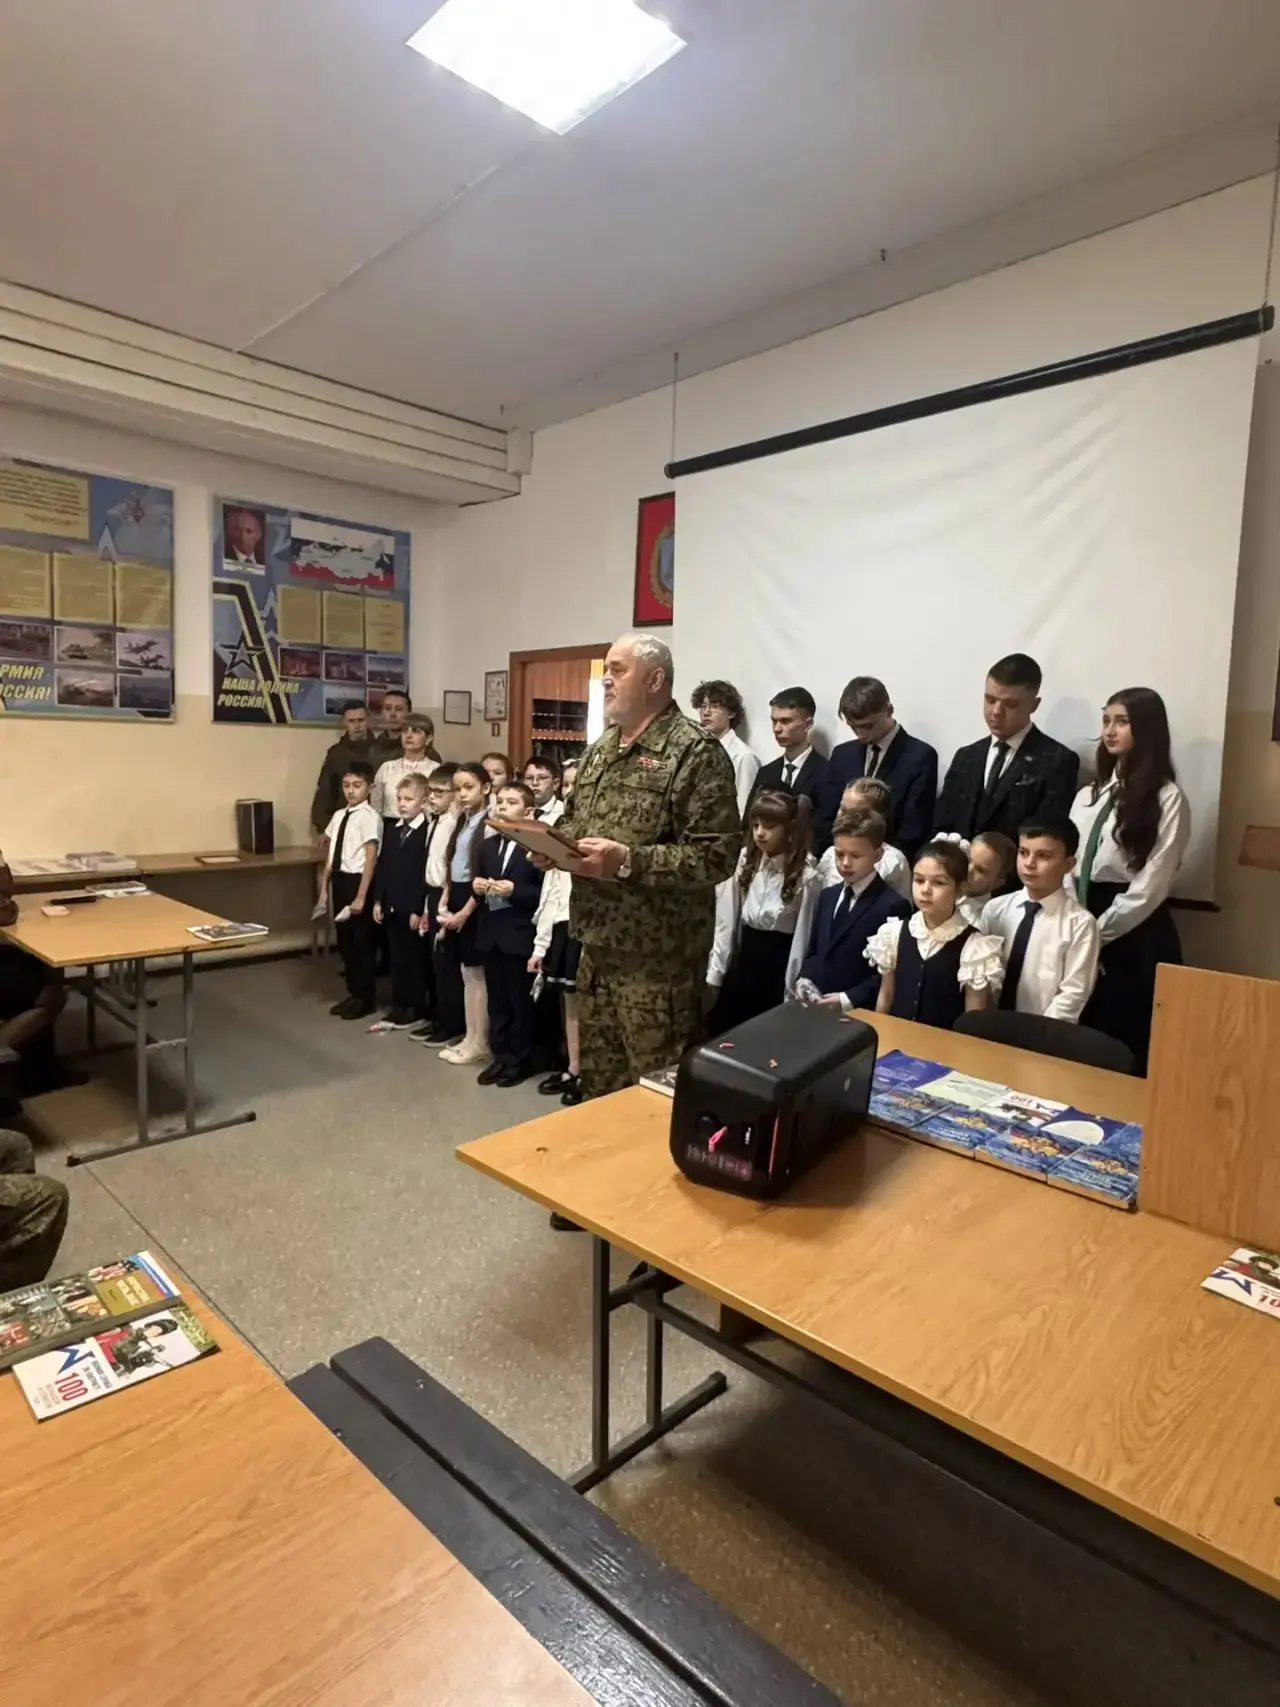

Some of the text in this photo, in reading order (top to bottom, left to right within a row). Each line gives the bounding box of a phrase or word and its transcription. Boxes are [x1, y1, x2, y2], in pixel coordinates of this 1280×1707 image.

[222, 676, 256, 691] НАША
[257, 679, 300, 694] РОДИНА
[54, 1372, 89, 1402] 100
